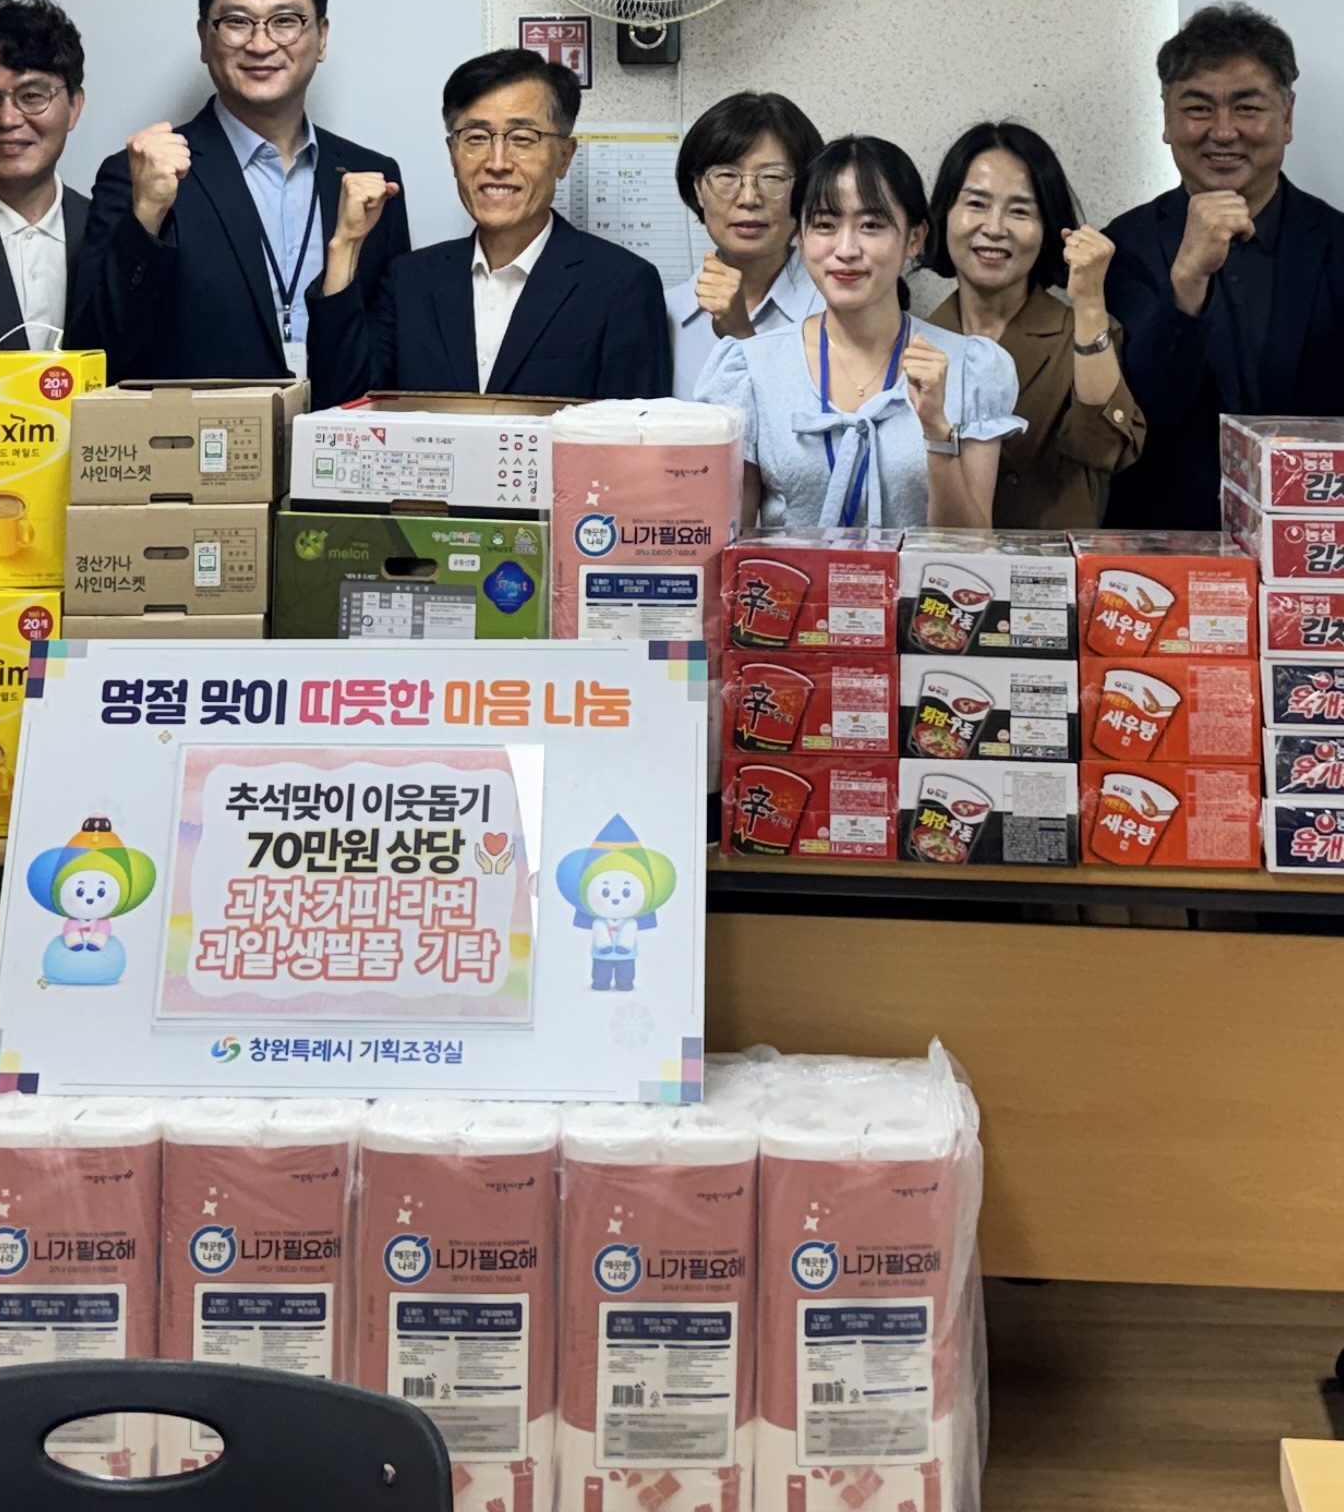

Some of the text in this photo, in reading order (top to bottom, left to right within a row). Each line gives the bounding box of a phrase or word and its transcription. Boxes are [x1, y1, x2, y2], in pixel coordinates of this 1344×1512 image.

[528, 26, 581, 38] 소화기
[44, 378, 69, 389] 20개
[12, 448, 40, 458] 마일드
[81, 445, 137, 462] 경산가나
[81, 465, 151, 482] 샤인머스켓
[1304, 458, 1333, 471] 농심
[586, 537, 604, 546] 나라
[621, 526, 711, 545] 니가필요해
[1305, 529, 1335, 542] 농심
[328, 548, 369, 560] melon
[76, 556, 132, 572] 경산가나
[75, 576, 146, 593] 샤인머스켓
[921, 597, 975, 630] 튀김우동
[1301, 601, 1330, 614] 농심
[23, 618, 48, 629] 20개
[1096, 610, 1152, 641] 새우탕
[101, 679, 631, 727] 명절 맞이 따뜻한 마음 나눔
[921, 706, 975, 740] 튀김우동
[1102, 710, 1158, 741] 새우탕
[226, 783, 490, 822] 추석맞이 이웃돕기
[921, 808, 974, 843] 튀김우동
[1101, 813, 1156, 846] 새우탕
[248, 828, 465, 874] 70만원 상당
[415, 929, 500, 982] 기탁
[249, 1038, 463, 1064] 창원특례시 기획조정실
[33, 1238, 136, 1261] 니가필요해
[202, 1252, 222, 1262] 나라
[241, 1237, 341, 1260] 니가필요해
[397, 1261, 417, 1271] 나라
[436, 1246, 537, 1270] 니가필요해
[843, 1251, 940, 1275] 니가필요해
[607, 1271, 627, 1281] 나라
[646, 1256, 746, 1279] 니가필요해
[805, 1268, 825, 1278] 나라
